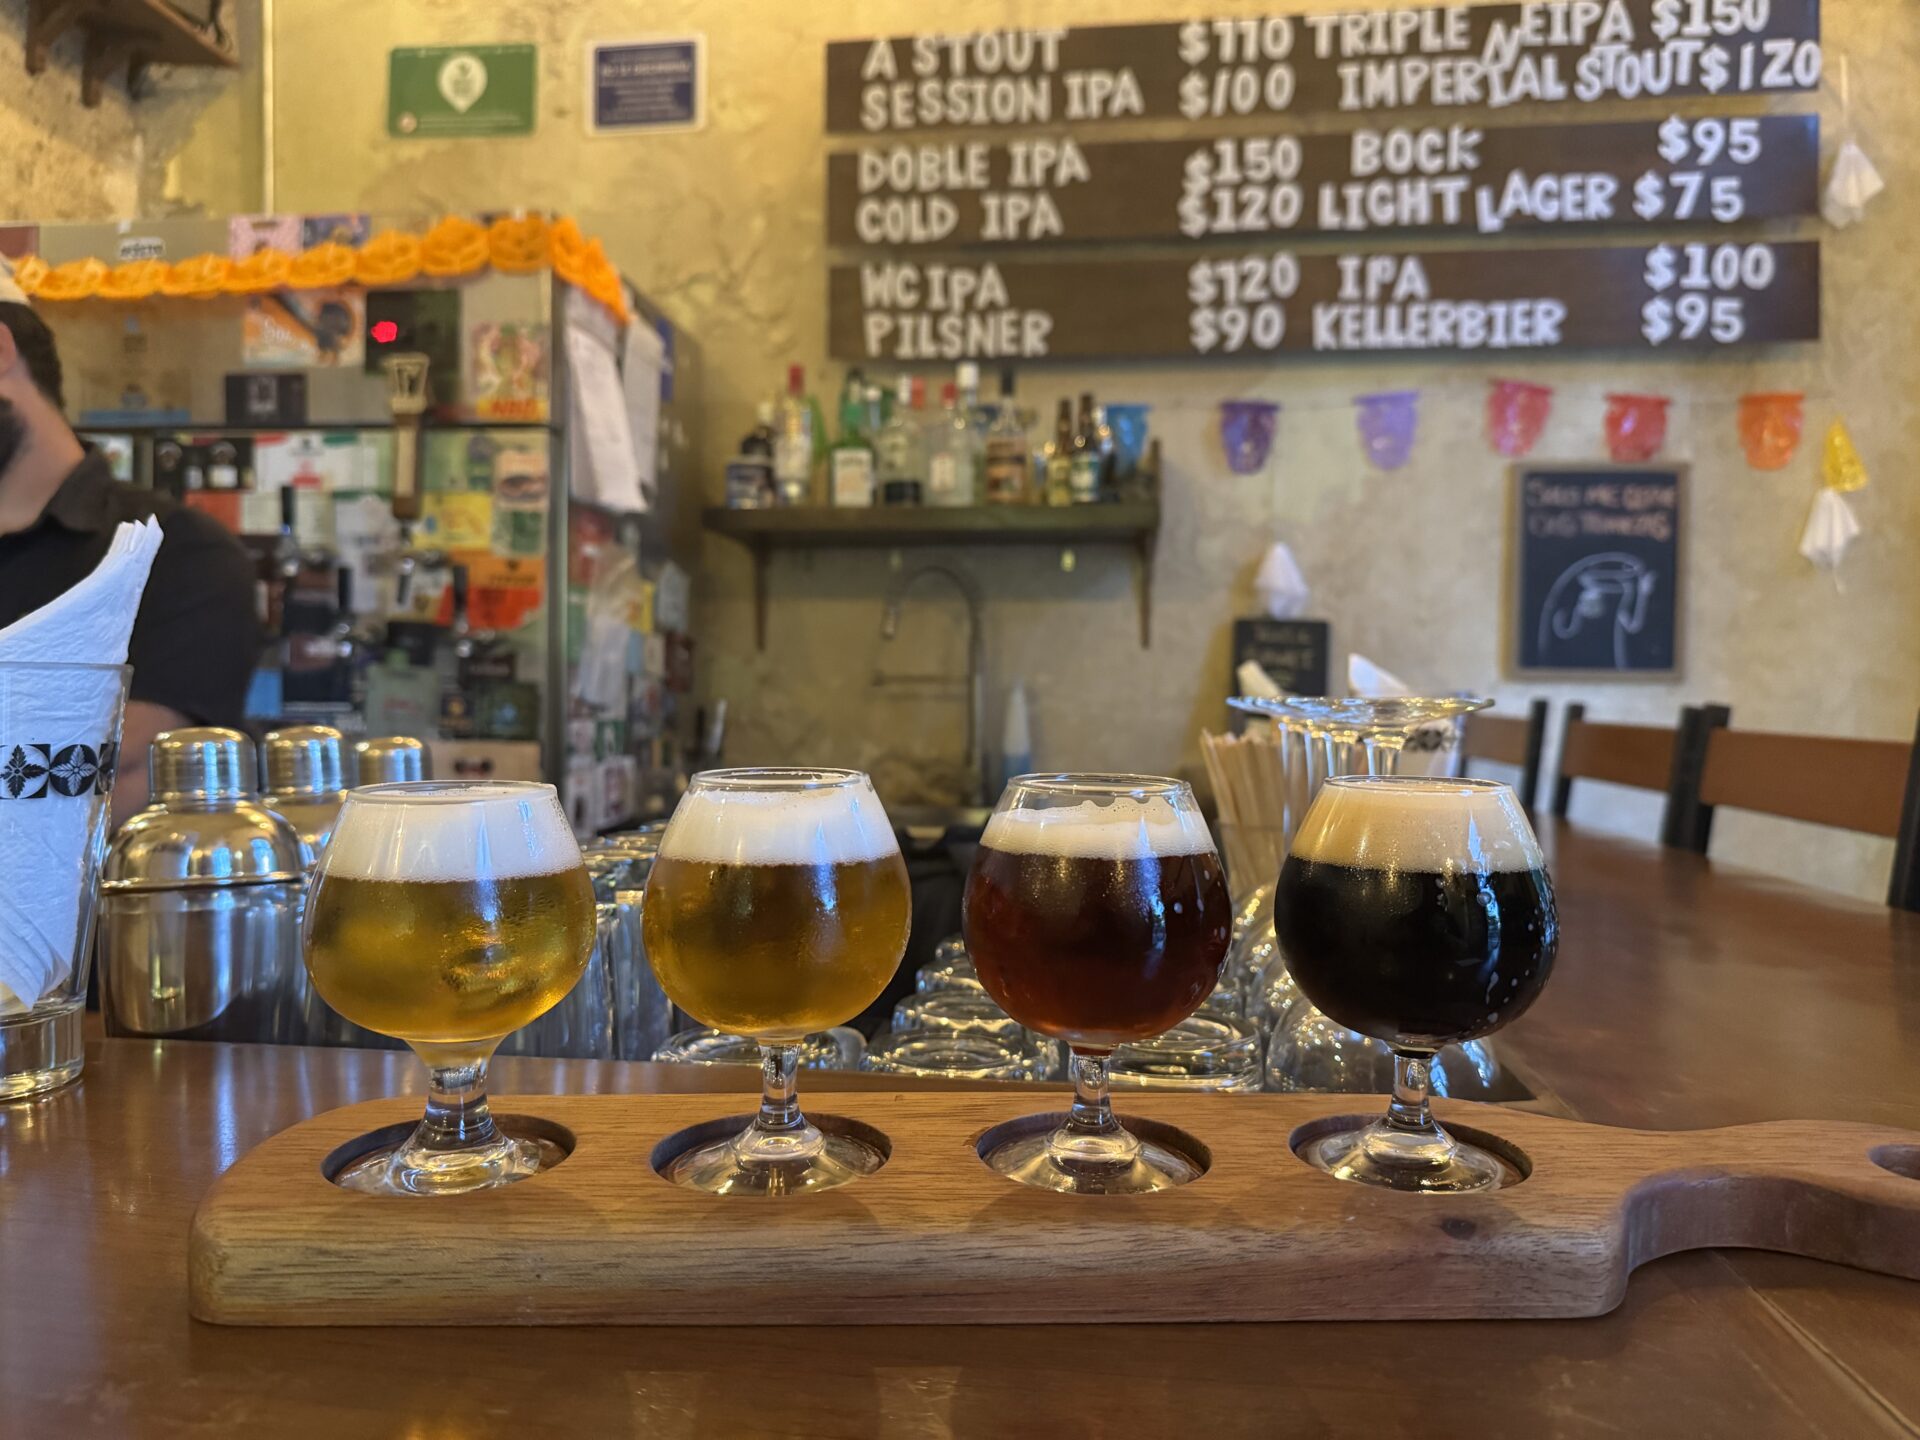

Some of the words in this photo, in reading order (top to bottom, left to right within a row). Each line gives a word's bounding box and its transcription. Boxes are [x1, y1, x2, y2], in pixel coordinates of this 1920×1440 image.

[862, 39, 898, 80] A
[911, 27, 1069, 76] STOUT
[1178, 16, 1295, 65] $110
[1304, 7, 1471, 58] TRIPLE
[1481, 0, 1636, 71] NEIPA
[1651, 0, 1771, 41] $150
[860, 76, 1051, 131] SESSION
[1063, 67, 1145, 120] IPA
[1337, 55, 1568, 111] IMPERIAL
[1574, 39, 1706, 101] STOUT
[857, 143, 991, 194] DOBLE
[1007, 136, 1091, 188] IPA
[1183, 135, 1303, 193] $150
[1350, 124, 1485, 177] BOCK
[1657, 113, 1763, 165] $95
[855, 197, 960, 244] COLD
[979, 192, 1064, 240] IPA
[1178, 184, 1304, 239] $120
[1316, 176, 1471, 231] LIGHT
[1475, 168, 1619, 234] LAGER
[1633, 170, 1746, 223] $75
[1188, 251, 1301, 307] $120
[1337, 255, 1430, 301] IPA
[1643, 241, 1776, 293] $100
[862, 310, 1054, 359] PILSNER
[1189, 303, 1286, 353] $90
[1310, 297, 1569, 351] KELLERBIER
[1640, 293, 1746, 345] $95
